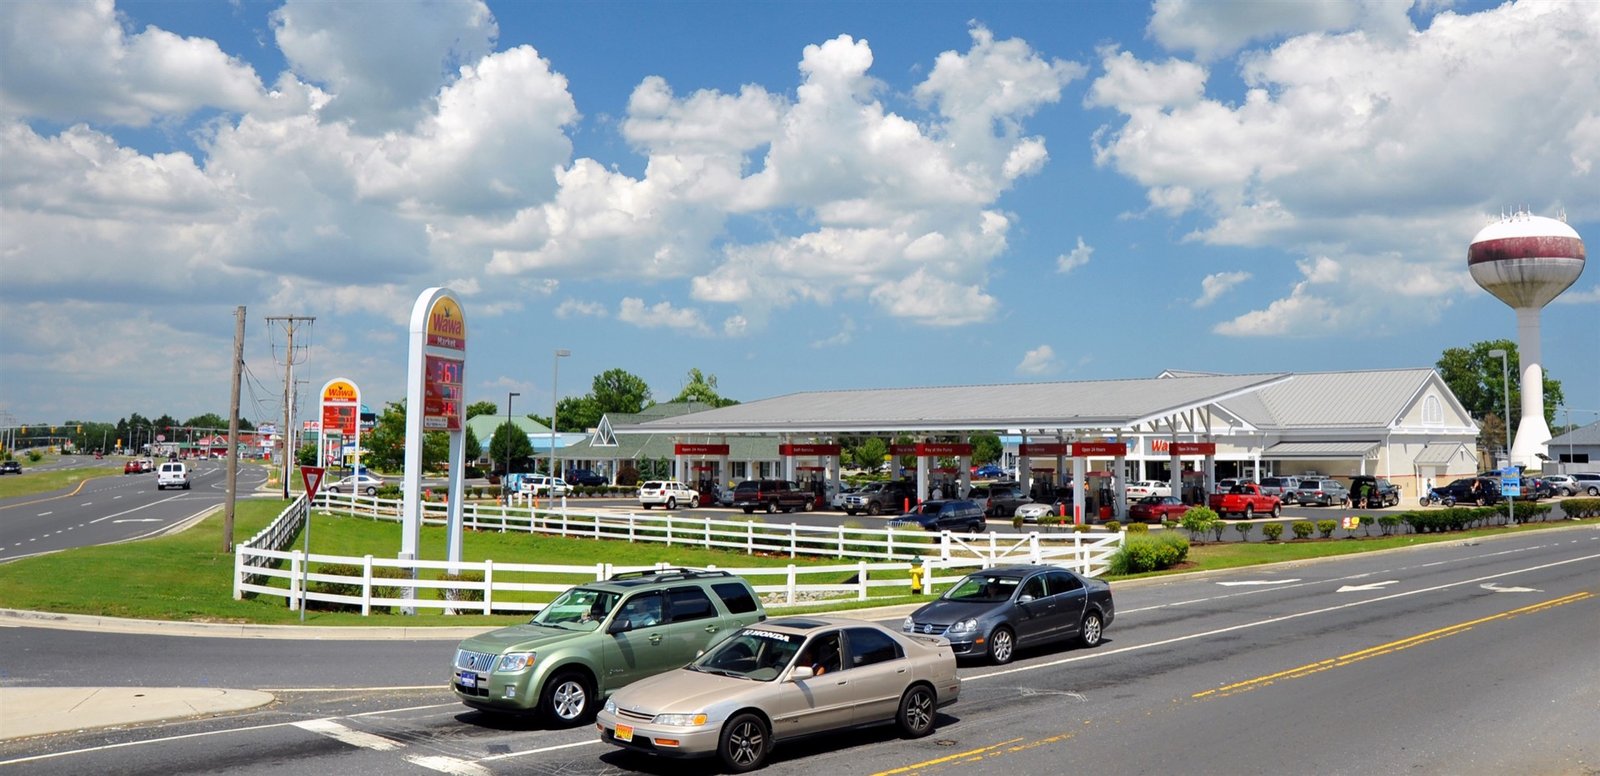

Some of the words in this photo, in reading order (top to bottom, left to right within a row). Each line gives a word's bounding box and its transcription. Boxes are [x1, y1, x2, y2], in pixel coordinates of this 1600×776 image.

[433, 313, 461, 335] Wawa
[437, 336, 456, 347] Market
[329, 388, 353, 397] Wawa
[1152, 440, 1169, 452] Wa
[751, 630, 790, 642] HONDA
